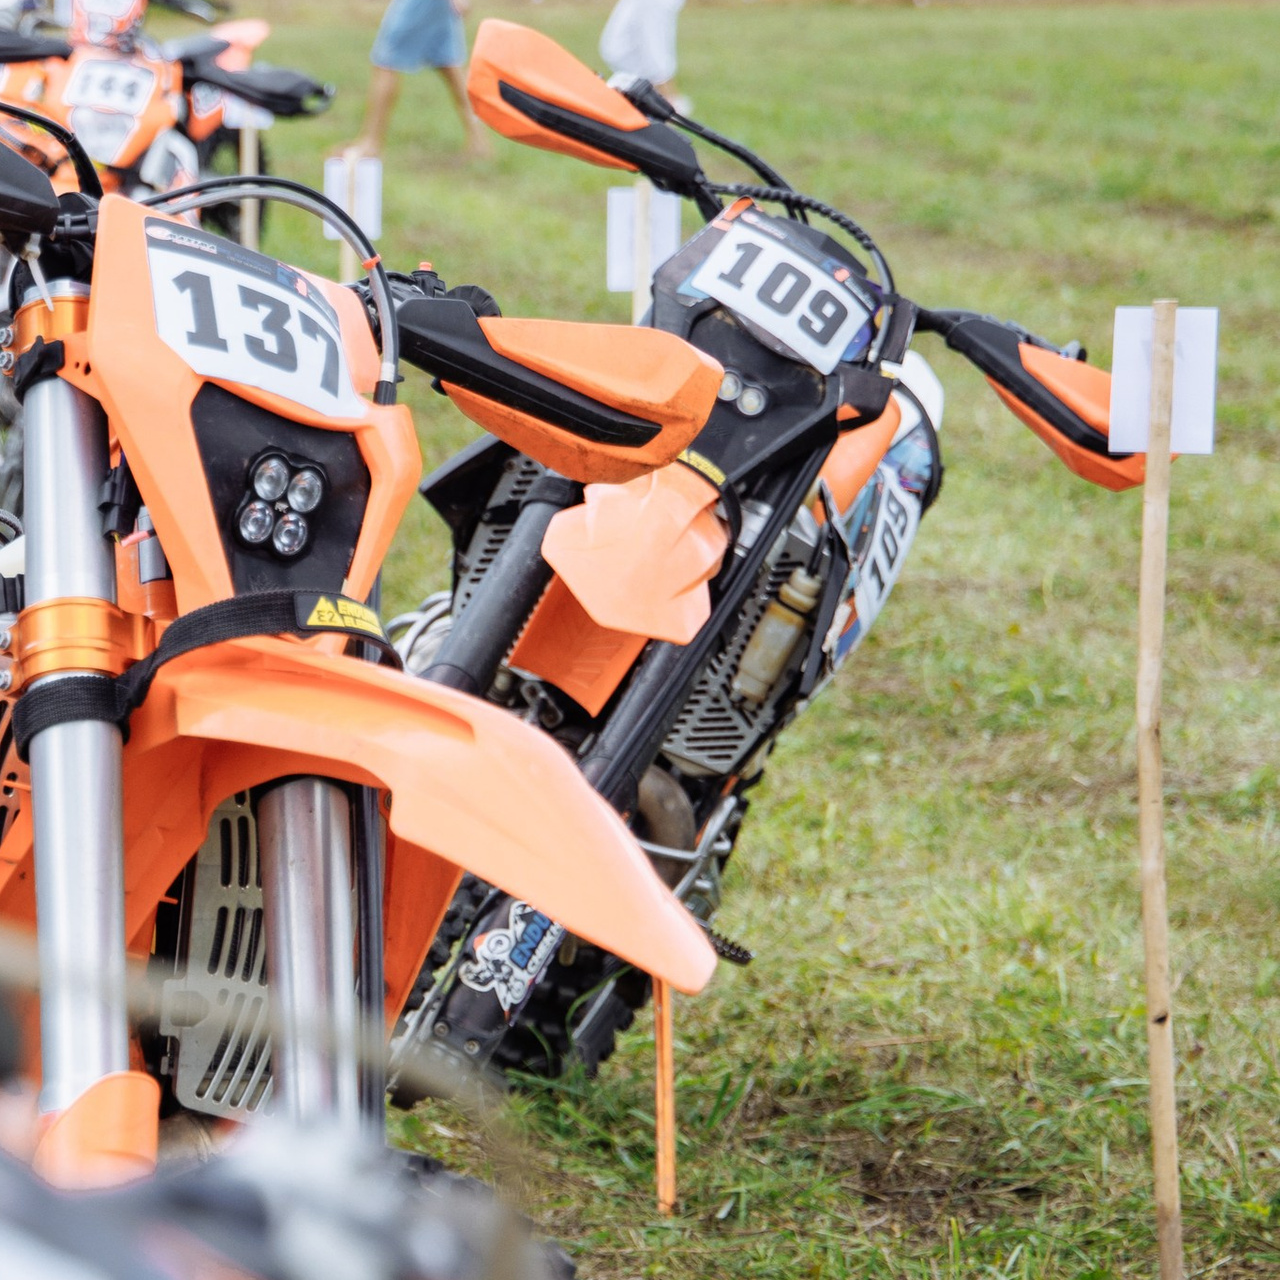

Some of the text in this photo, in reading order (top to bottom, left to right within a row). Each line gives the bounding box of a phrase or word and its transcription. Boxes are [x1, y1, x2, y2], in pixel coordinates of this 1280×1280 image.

[172, 269, 340, 399] 137
[718, 242, 849, 349] 109
[869, 488, 908, 600] 109
